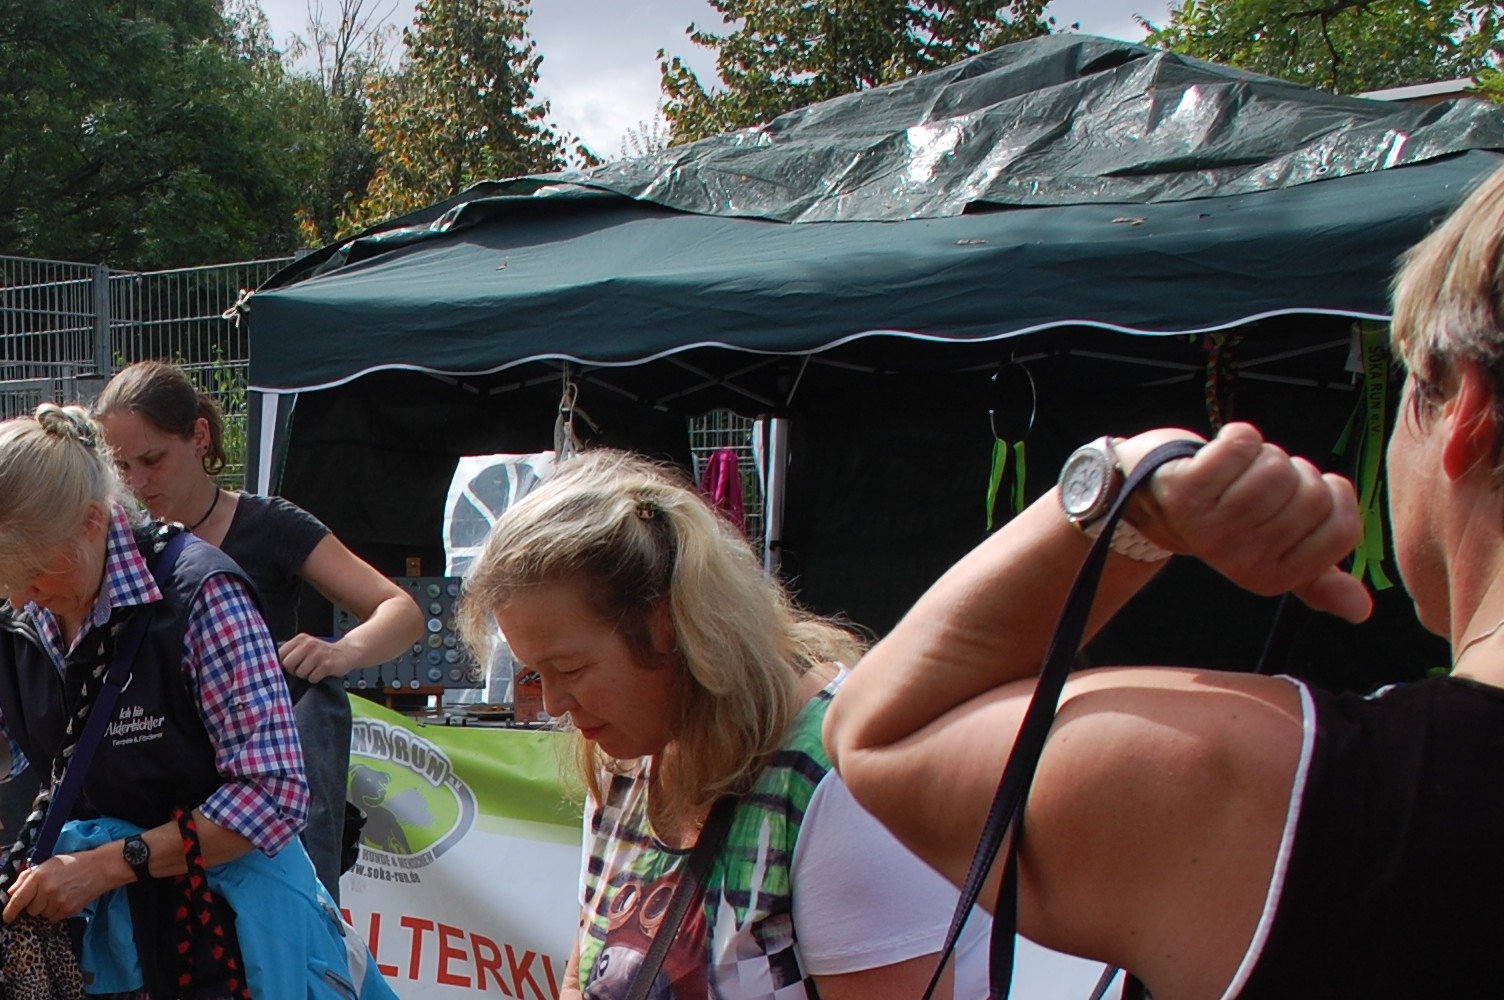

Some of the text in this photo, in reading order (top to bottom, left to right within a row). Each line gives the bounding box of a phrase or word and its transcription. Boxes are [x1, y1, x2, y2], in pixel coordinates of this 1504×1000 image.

[1368, 345, 1384, 379] SOKA
[1370, 383, 1383, 410] RUN
[119, 706, 144, 719] Ich bin
[394, 737, 446, 784] RUN
[362, 848, 391, 867] HUNDE
